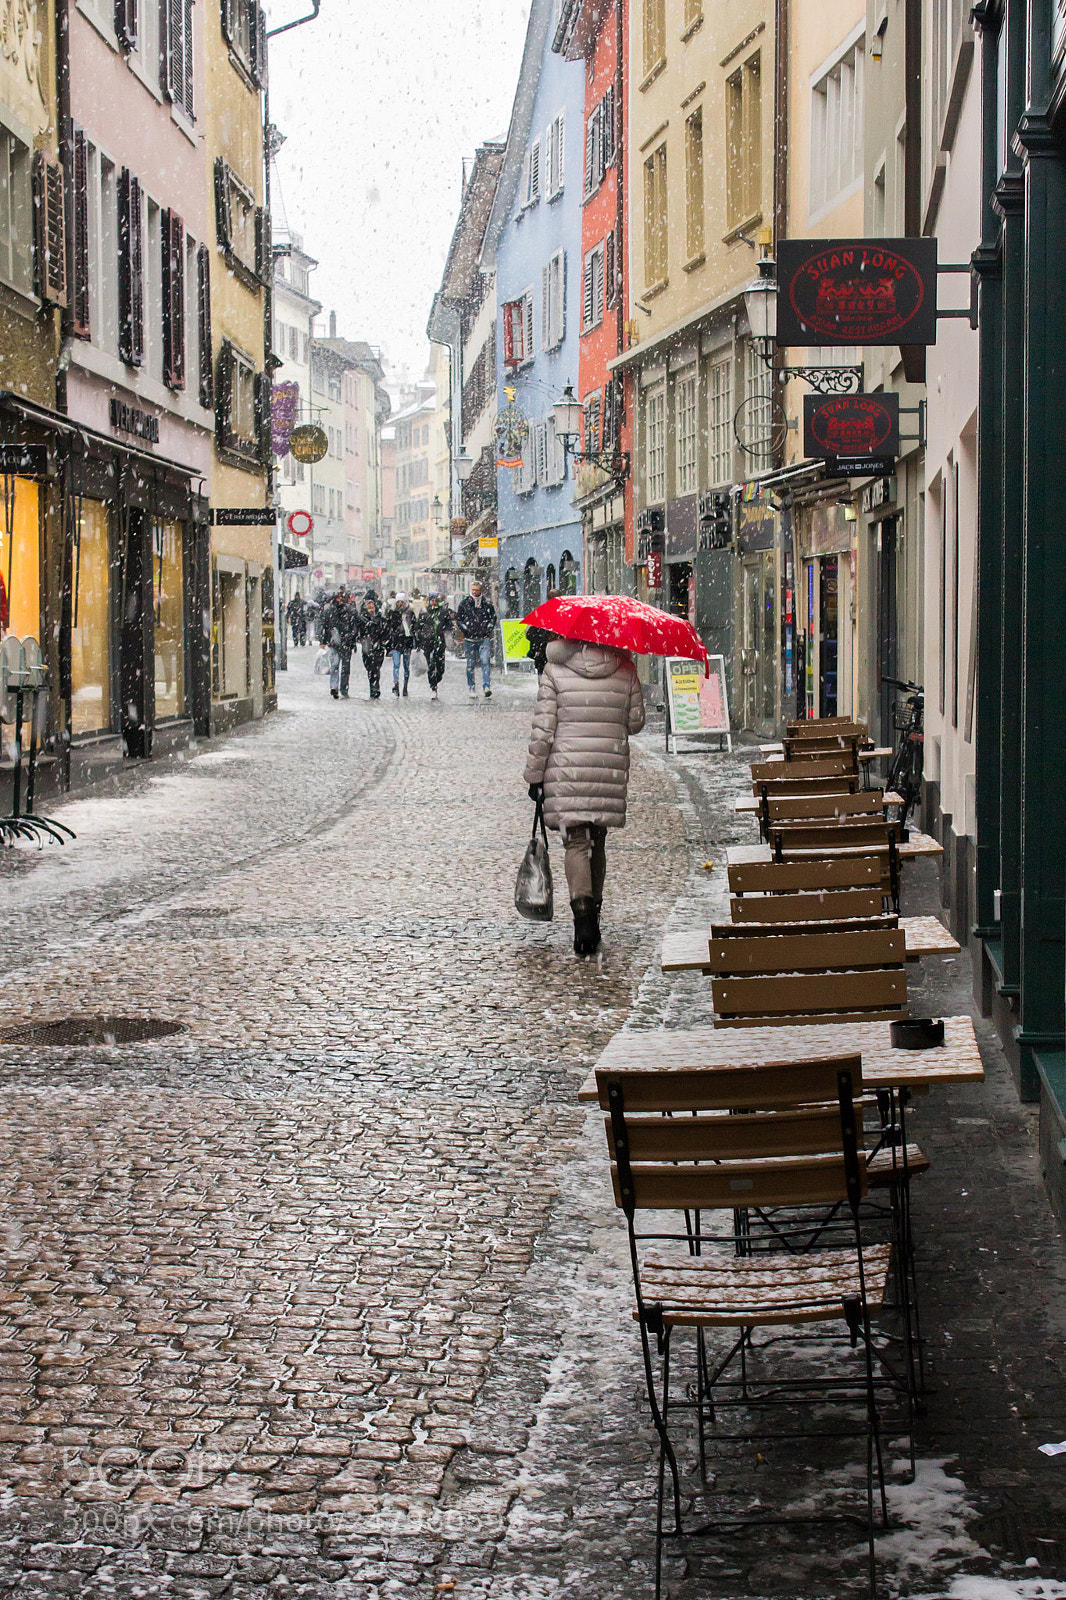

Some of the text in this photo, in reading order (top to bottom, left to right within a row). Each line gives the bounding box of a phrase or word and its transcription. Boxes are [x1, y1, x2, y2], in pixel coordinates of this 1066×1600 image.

[807, 250, 907, 280] SUAN LONG
[810, 313, 903, 335] ASIAN RESTAURANT
[821, 400, 882, 419] SUAN LONG
[861, 462, 884, 470] JONES
[672, 664, 706, 675] OPEN
